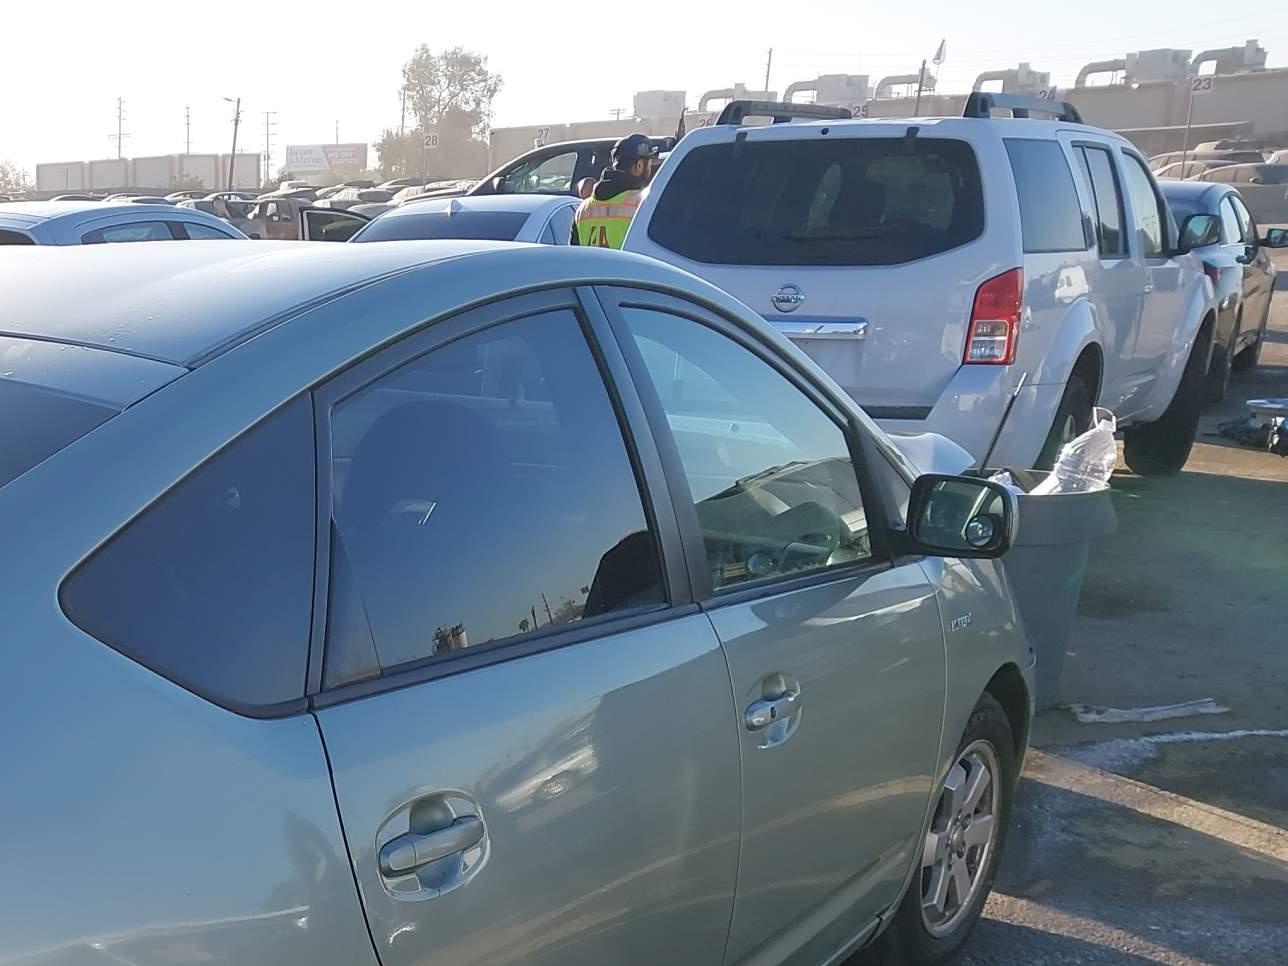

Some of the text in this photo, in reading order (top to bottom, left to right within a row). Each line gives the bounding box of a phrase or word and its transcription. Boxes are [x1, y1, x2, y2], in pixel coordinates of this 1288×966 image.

[1192, 77, 1212, 91] 23
[1039, 88, 1056, 100] 24
[852, 105, 868, 118] 25
[537, 128, 550, 139] 27
[425, 135, 438, 146] 28
